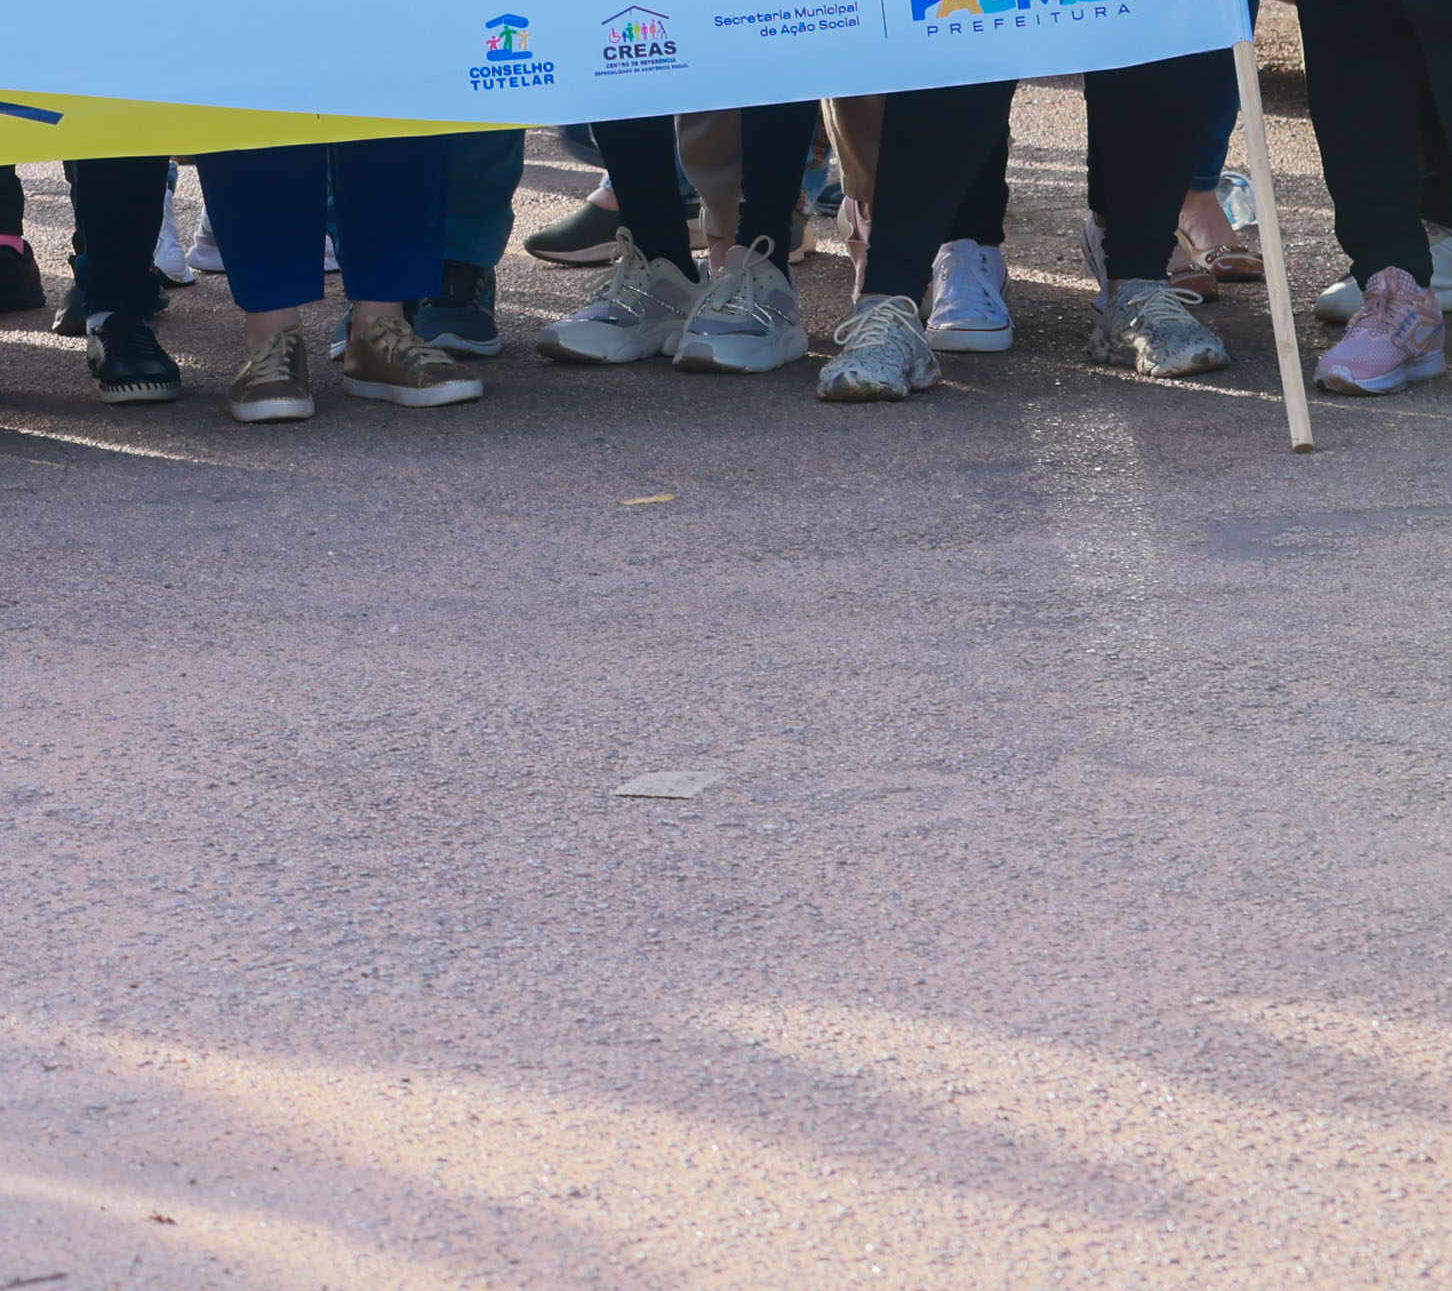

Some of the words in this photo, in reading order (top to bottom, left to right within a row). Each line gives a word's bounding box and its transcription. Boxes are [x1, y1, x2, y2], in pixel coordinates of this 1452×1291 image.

[714, 8, 792, 28] Secretaria
[795, 1, 859, 18] Municipal
[926, 3, 1131, 38] PREFEITURA
[759, 24, 778, 37] de
[780, 17, 817, 37] Ação
[819, 16, 860, 31] Social
[603, 40, 677, 61] CREAS
[469, 61, 555, 80] CONSELHO
[470, 74, 555, 91] TUTELAR
